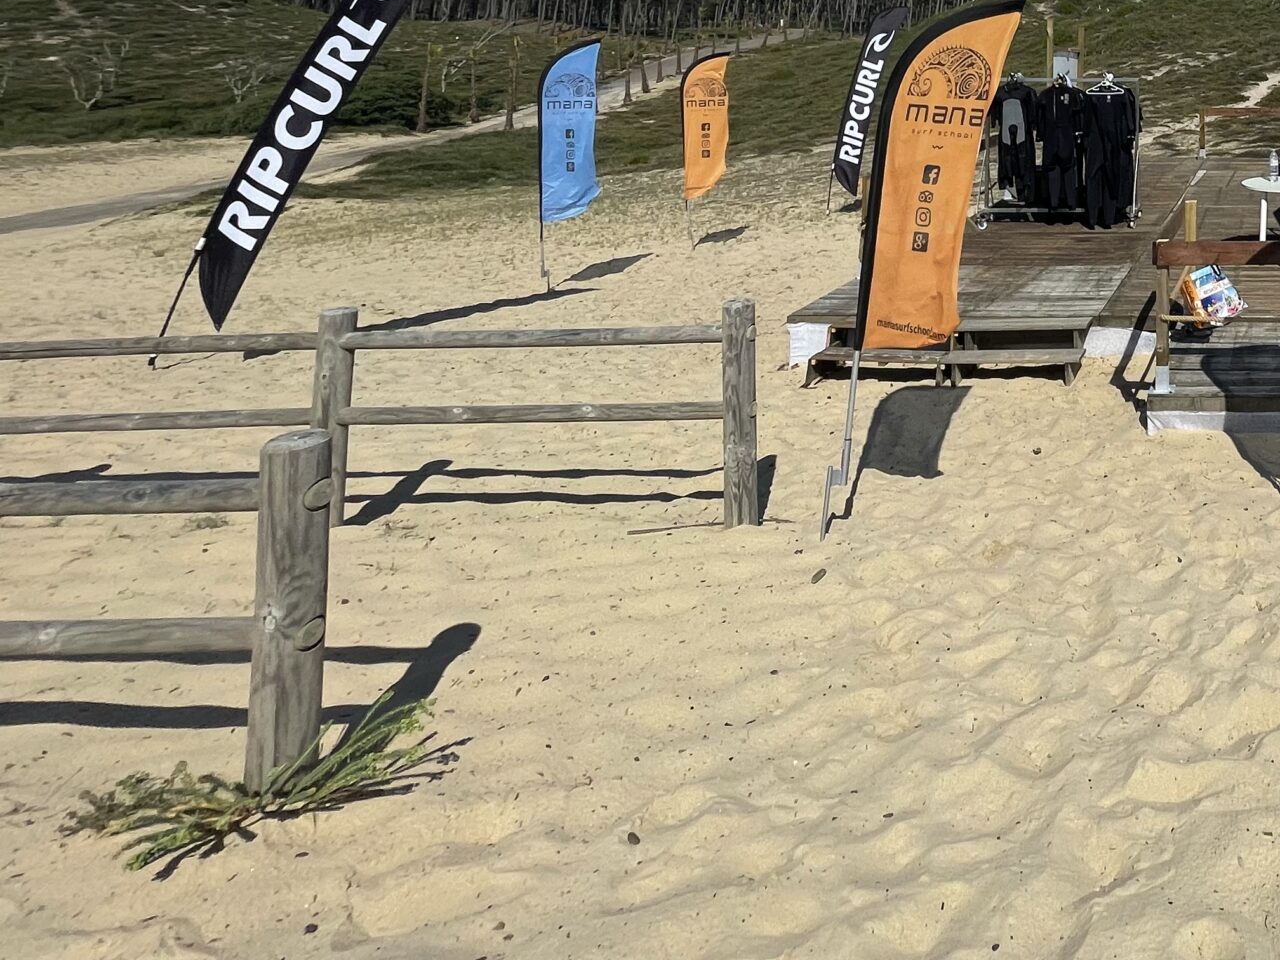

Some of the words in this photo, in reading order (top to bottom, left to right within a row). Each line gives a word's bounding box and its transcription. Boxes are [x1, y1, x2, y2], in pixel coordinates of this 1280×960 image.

[546, 100, 593, 109] mana
[686, 99, 725, 107] mana
[905, 103, 984, 127] mana
[937, 129, 973, 139] school
